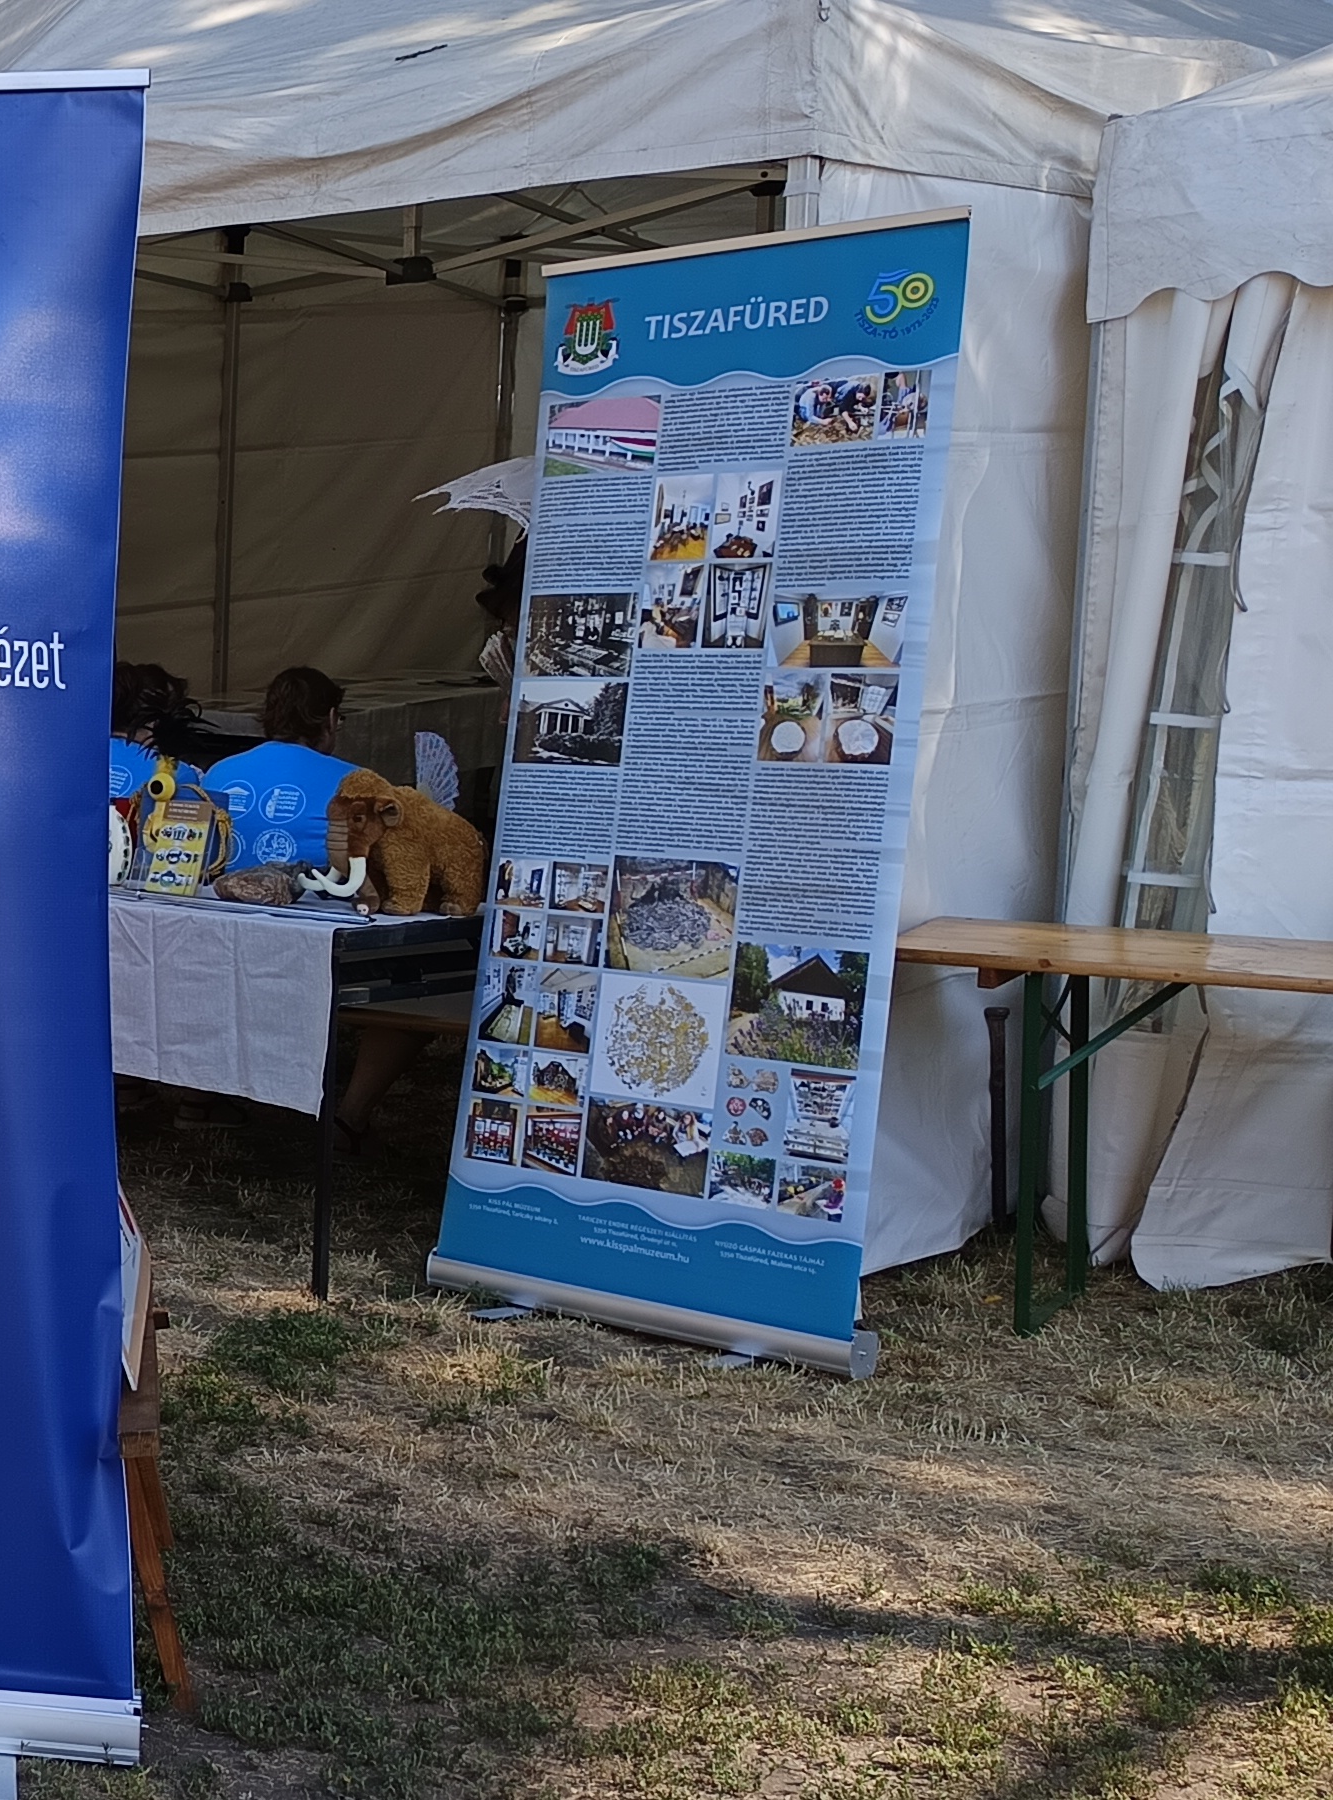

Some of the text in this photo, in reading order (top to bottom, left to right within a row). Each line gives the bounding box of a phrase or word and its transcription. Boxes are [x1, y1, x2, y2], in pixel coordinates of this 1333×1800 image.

[644, 296, 829, 341] TISZAFÜRED
[854, 308, 898, 339] TISZA-TÓ
[514, 1202, 541, 1213] MÚZEUM
[608, 1220, 628, 1230] ENDRE
[579, 1235, 690, 1264] www.kisspalmuzeum.hu
[739, 1243, 766, 1256] GÁSPÁR
[767, 1250, 798, 1262] FAZEKAS
